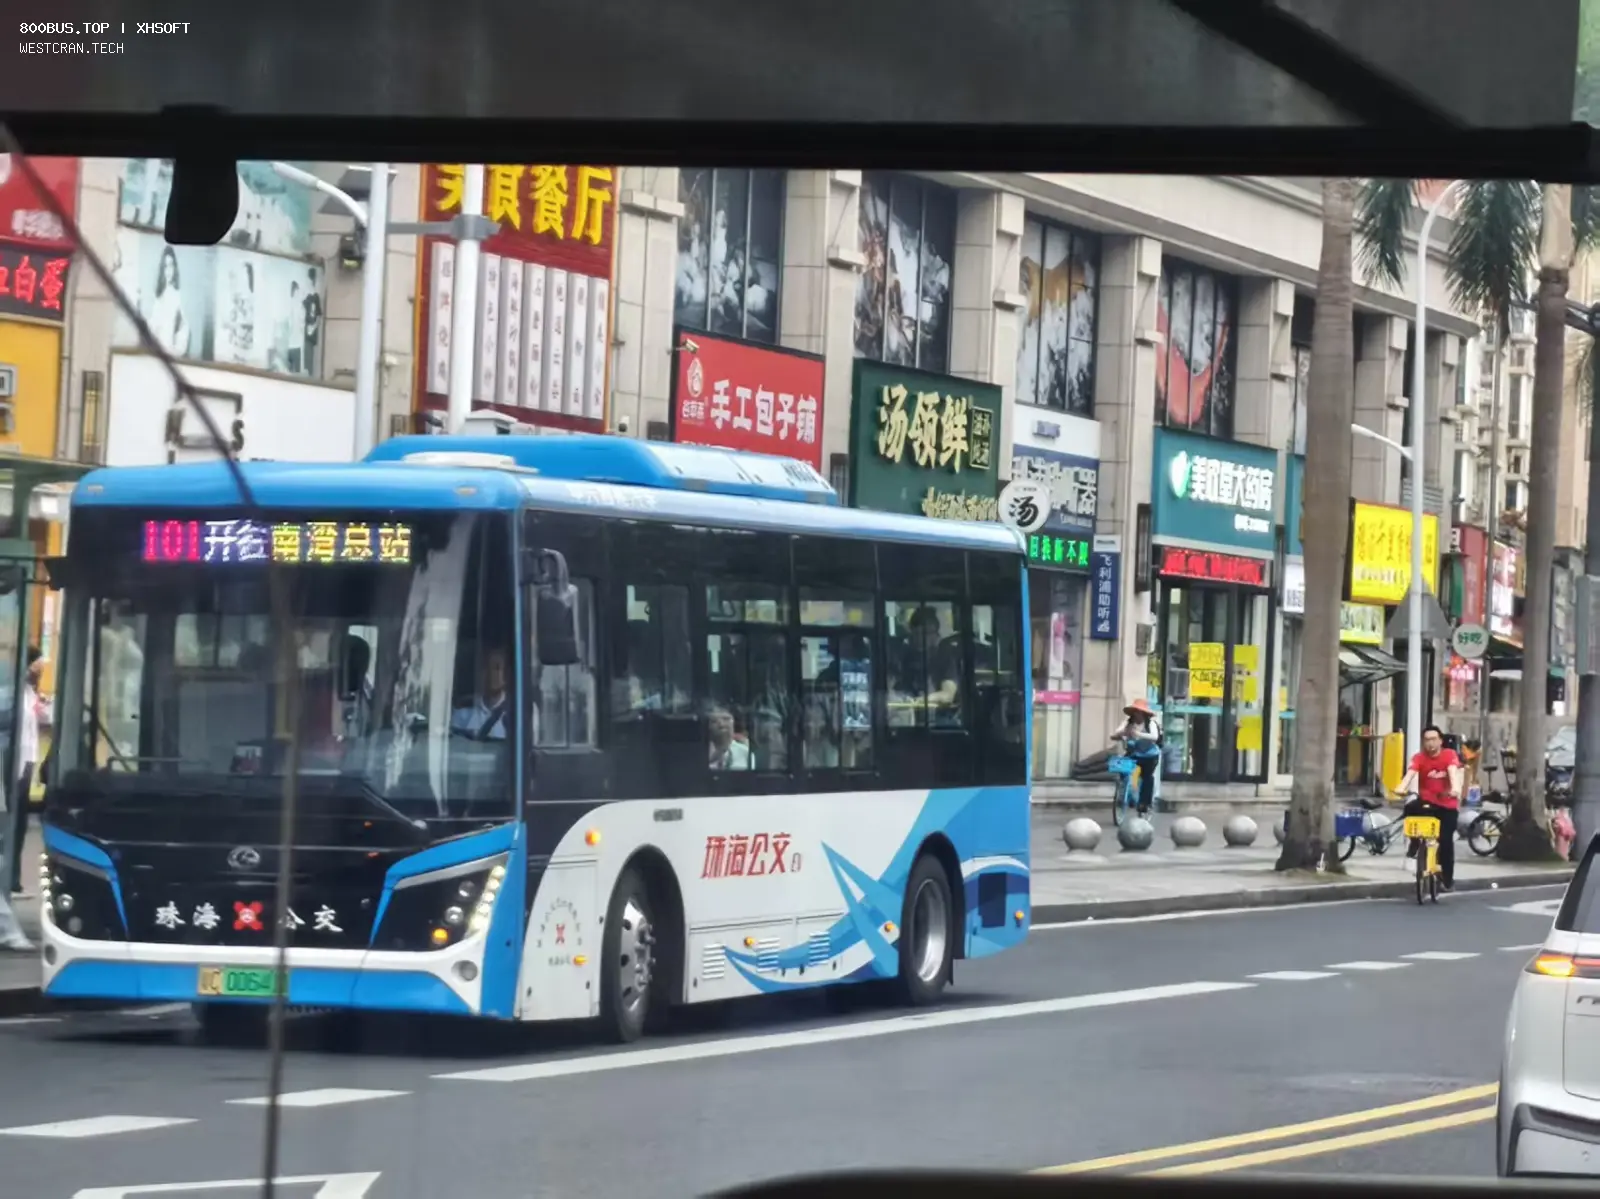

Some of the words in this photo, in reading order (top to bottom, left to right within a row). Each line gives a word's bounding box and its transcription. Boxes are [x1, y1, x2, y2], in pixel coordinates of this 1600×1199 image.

[710, 379, 818, 444] 手工包子铺
[878, 383, 969, 474] 汤领鲜
[1008, 495, 1040, 528] 汤
[142, 520, 200, 562] 101
[701, 832, 792, 879] 珠海公交
